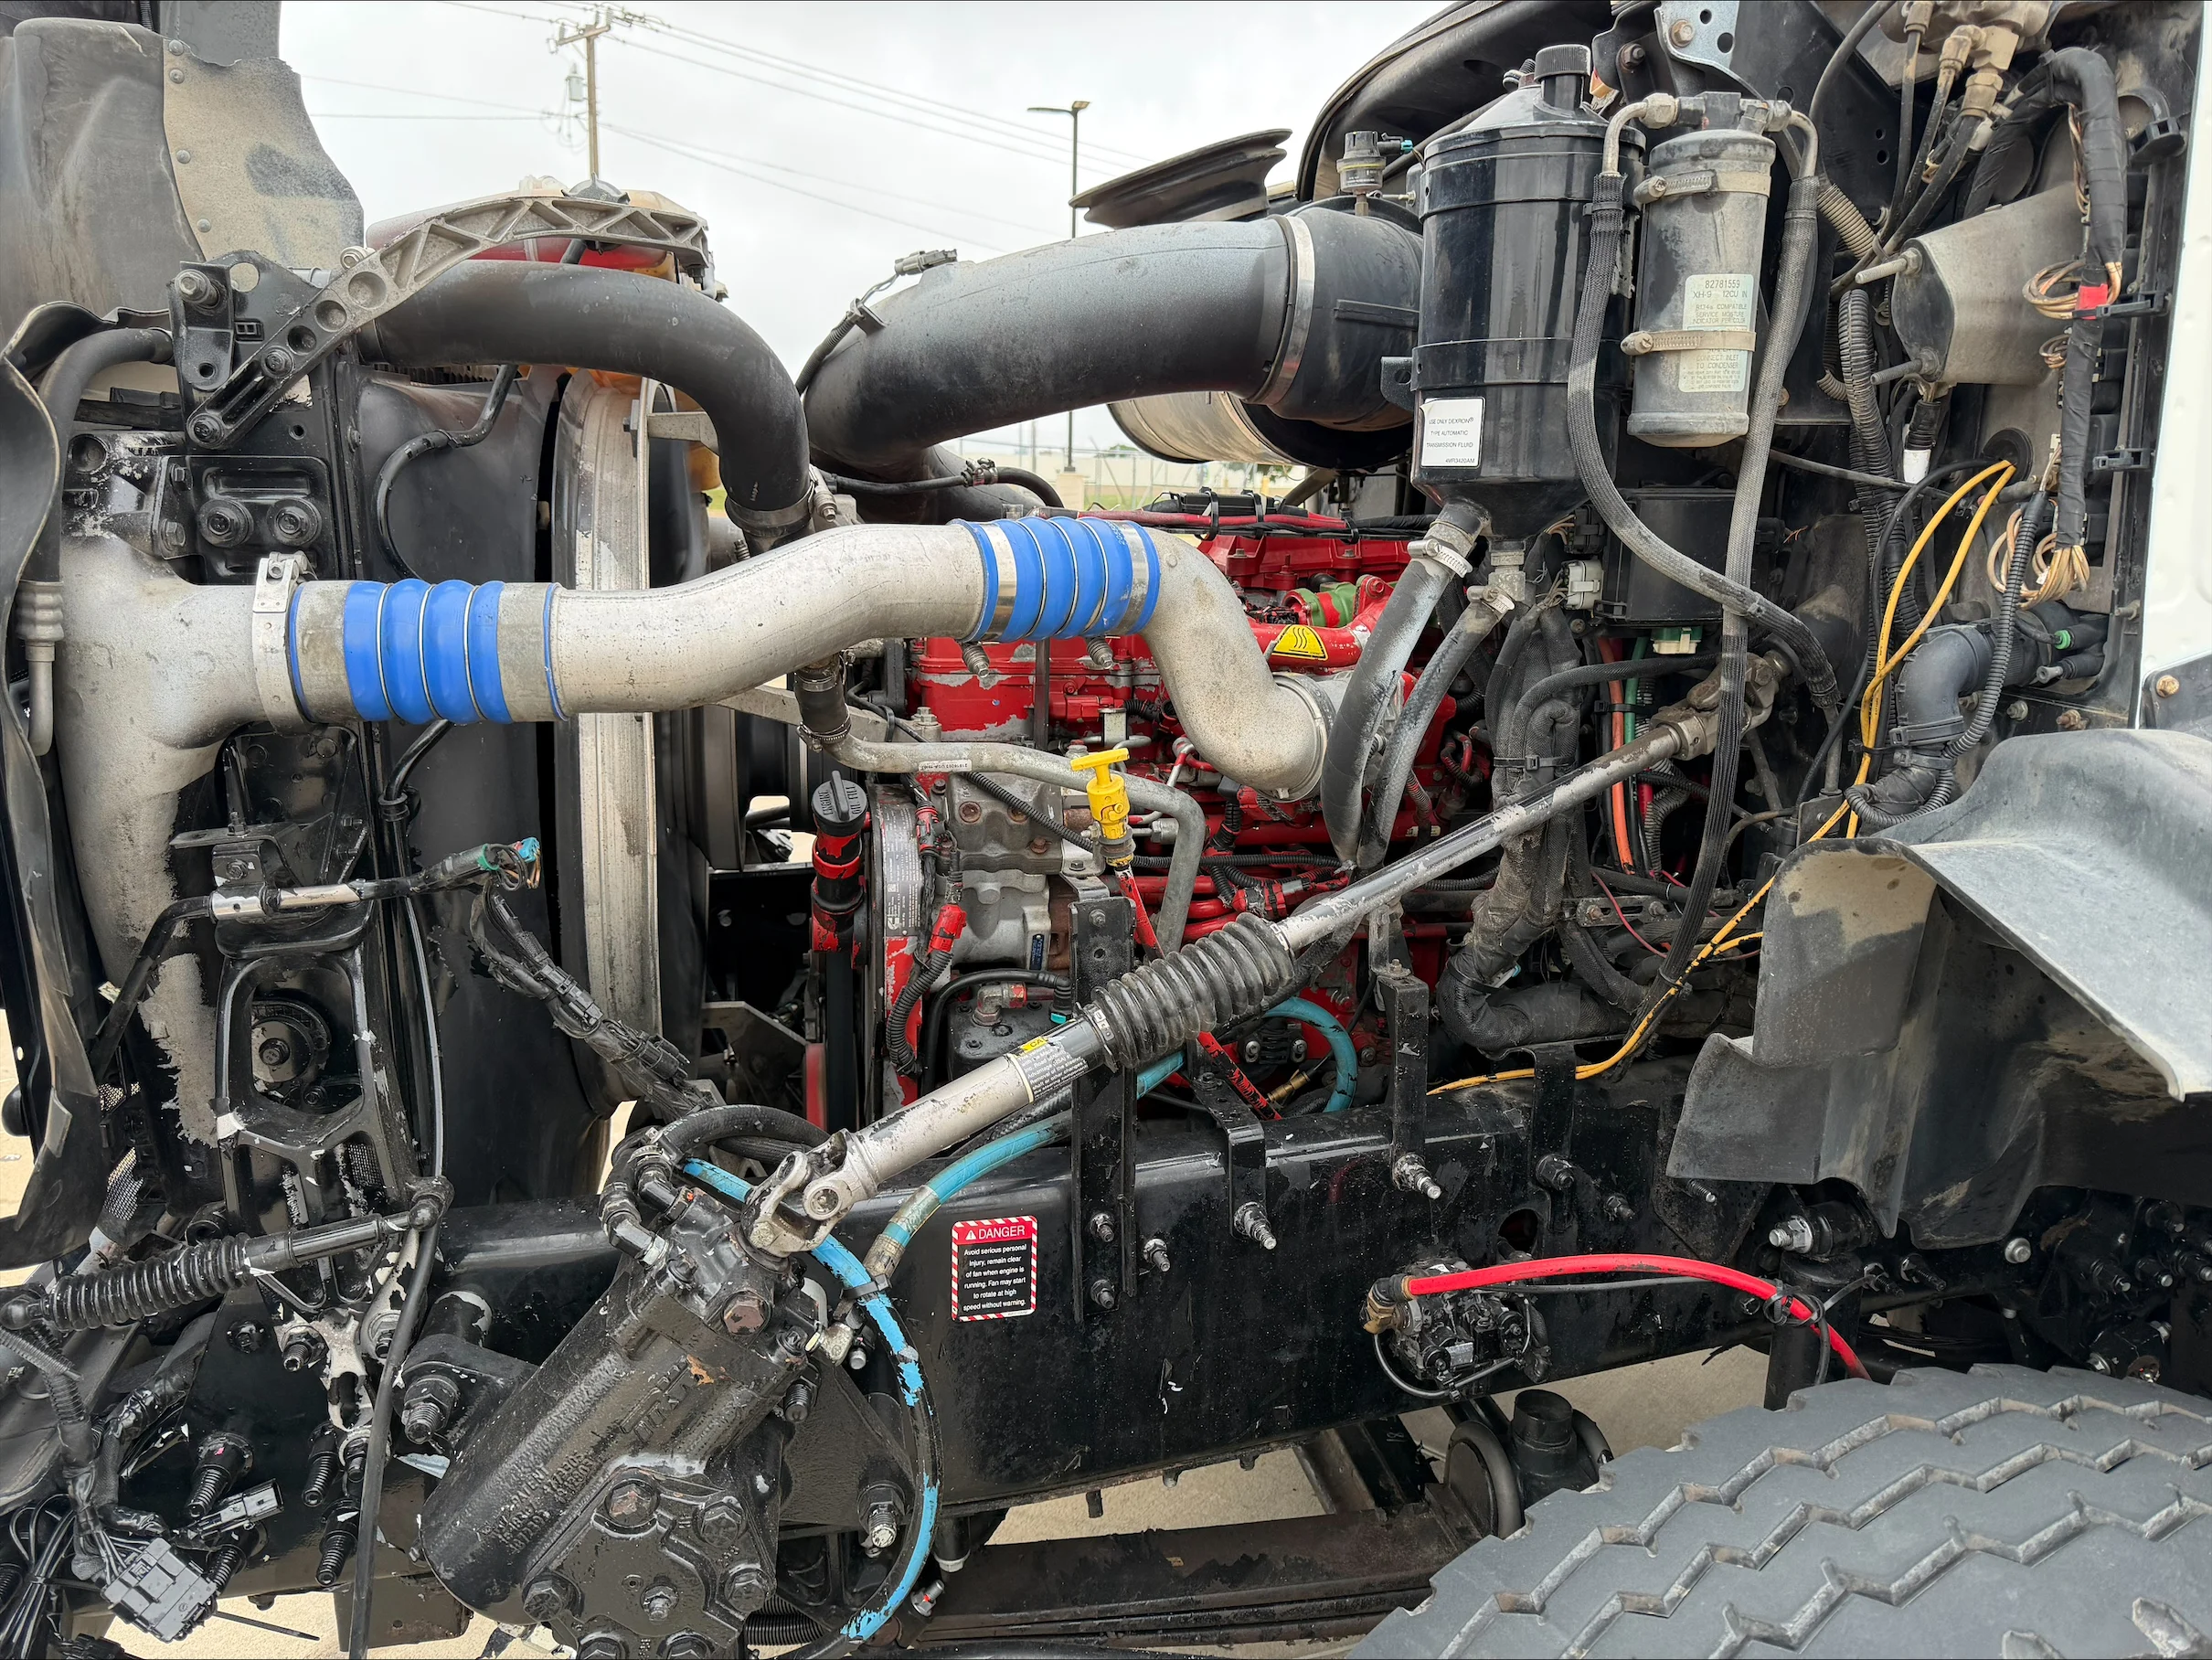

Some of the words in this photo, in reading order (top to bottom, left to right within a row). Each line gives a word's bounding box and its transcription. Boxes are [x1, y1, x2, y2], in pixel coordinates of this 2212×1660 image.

[1705, 280, 1740, 288] 82781559
[845, 785, 858, 799] FILL
[818, 790, 834, 815] ENGINE
[850, 802, 862, 814] OIL
[979, 1225, 1025, 1239] DANGER
[1002, 1244, 1027, 1254] personal
[999, 1267, 1018, 1276] engine
[964, 1281, 987, 1289] running.
[1000, 1278, 1012, 1287] may
[963, 1303, 981, 1312] speed
[981, 1301, 1002, 1309] without
[1002, 1298, 1026, 1307] warning.
